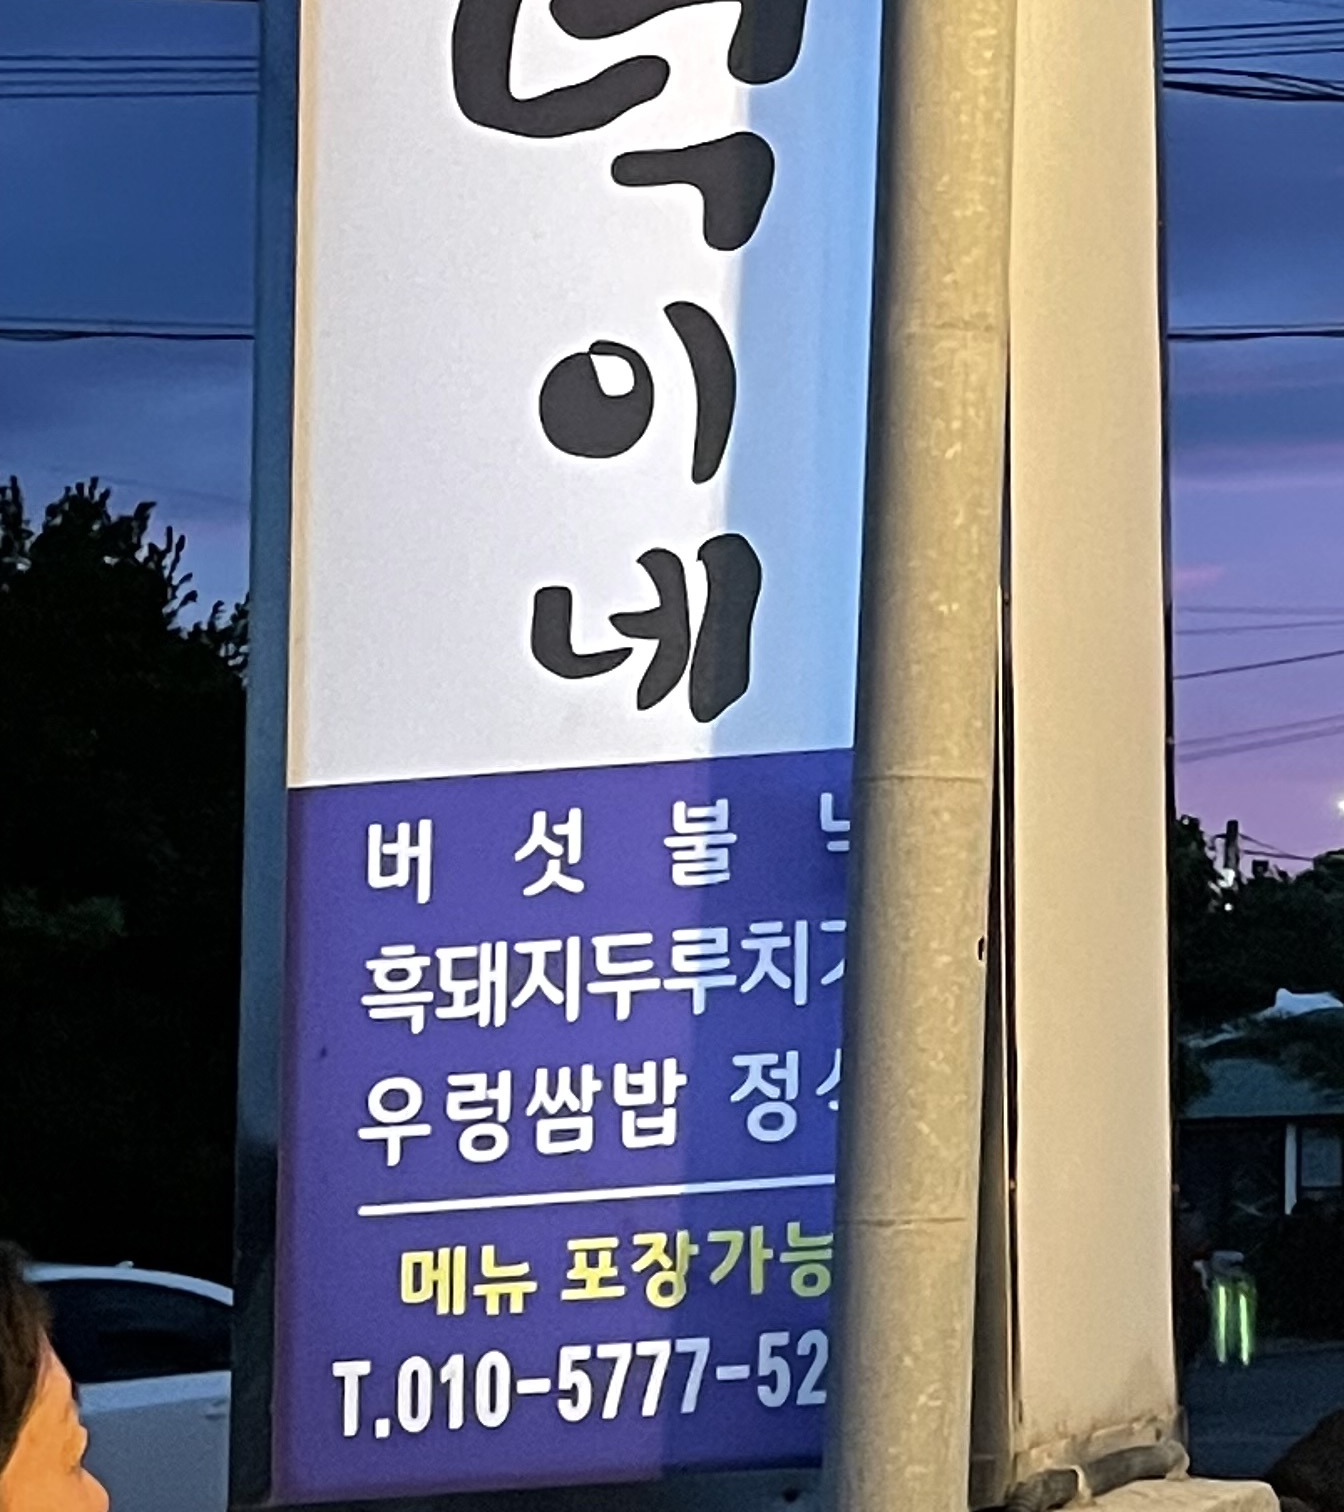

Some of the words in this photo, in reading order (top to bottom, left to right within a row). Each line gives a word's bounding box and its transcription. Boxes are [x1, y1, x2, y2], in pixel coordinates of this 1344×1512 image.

[357, 1056, 688, 1167] 우렁쌈밥
[730, 1048, 842, 1143] 정
[399, 1245, 537, 1315] 메뉴
